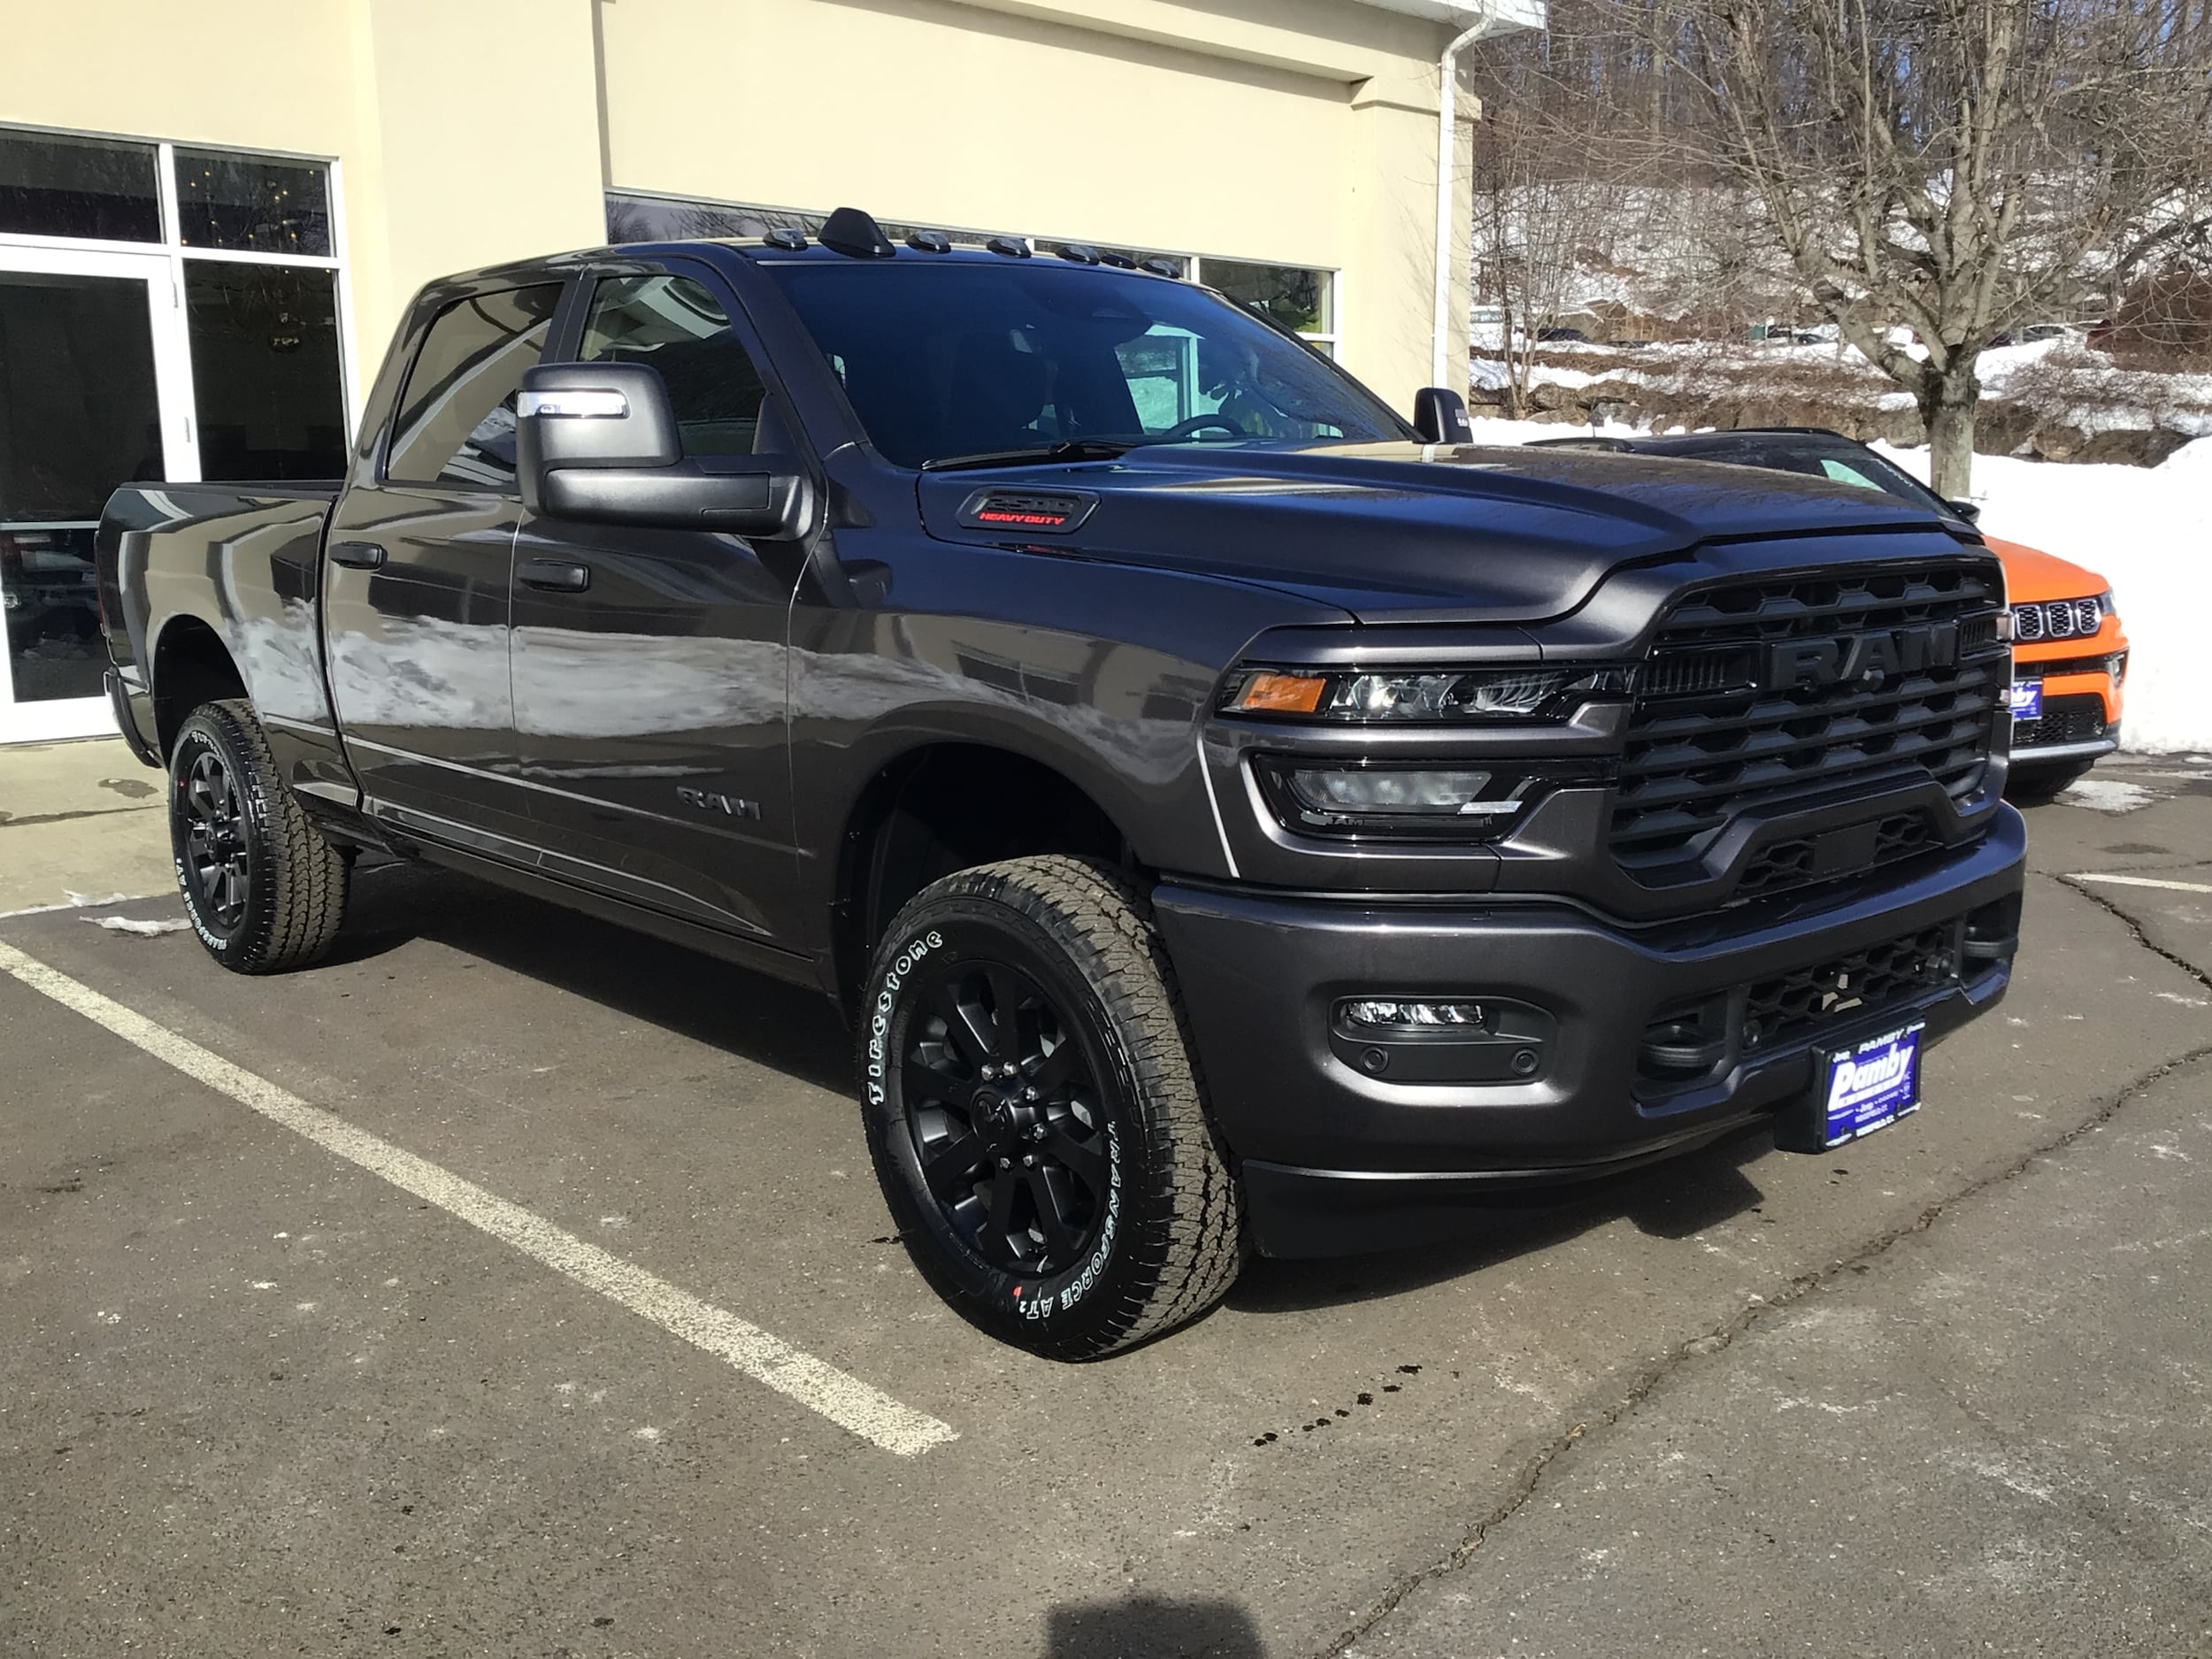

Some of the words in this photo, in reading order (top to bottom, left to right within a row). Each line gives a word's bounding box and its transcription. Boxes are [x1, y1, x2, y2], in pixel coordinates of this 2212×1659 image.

[979, 512, 1024, 523] HEAVY
[1024, 516, 1065, 526] DUTY
[1770, 621, 1958, 690] RAM
[676, 785, 761, 821] RAM
[1827, 1042, 1915, 1112] Pamby
[1062, 1121, 1121, 1310] TRANSFORCE
